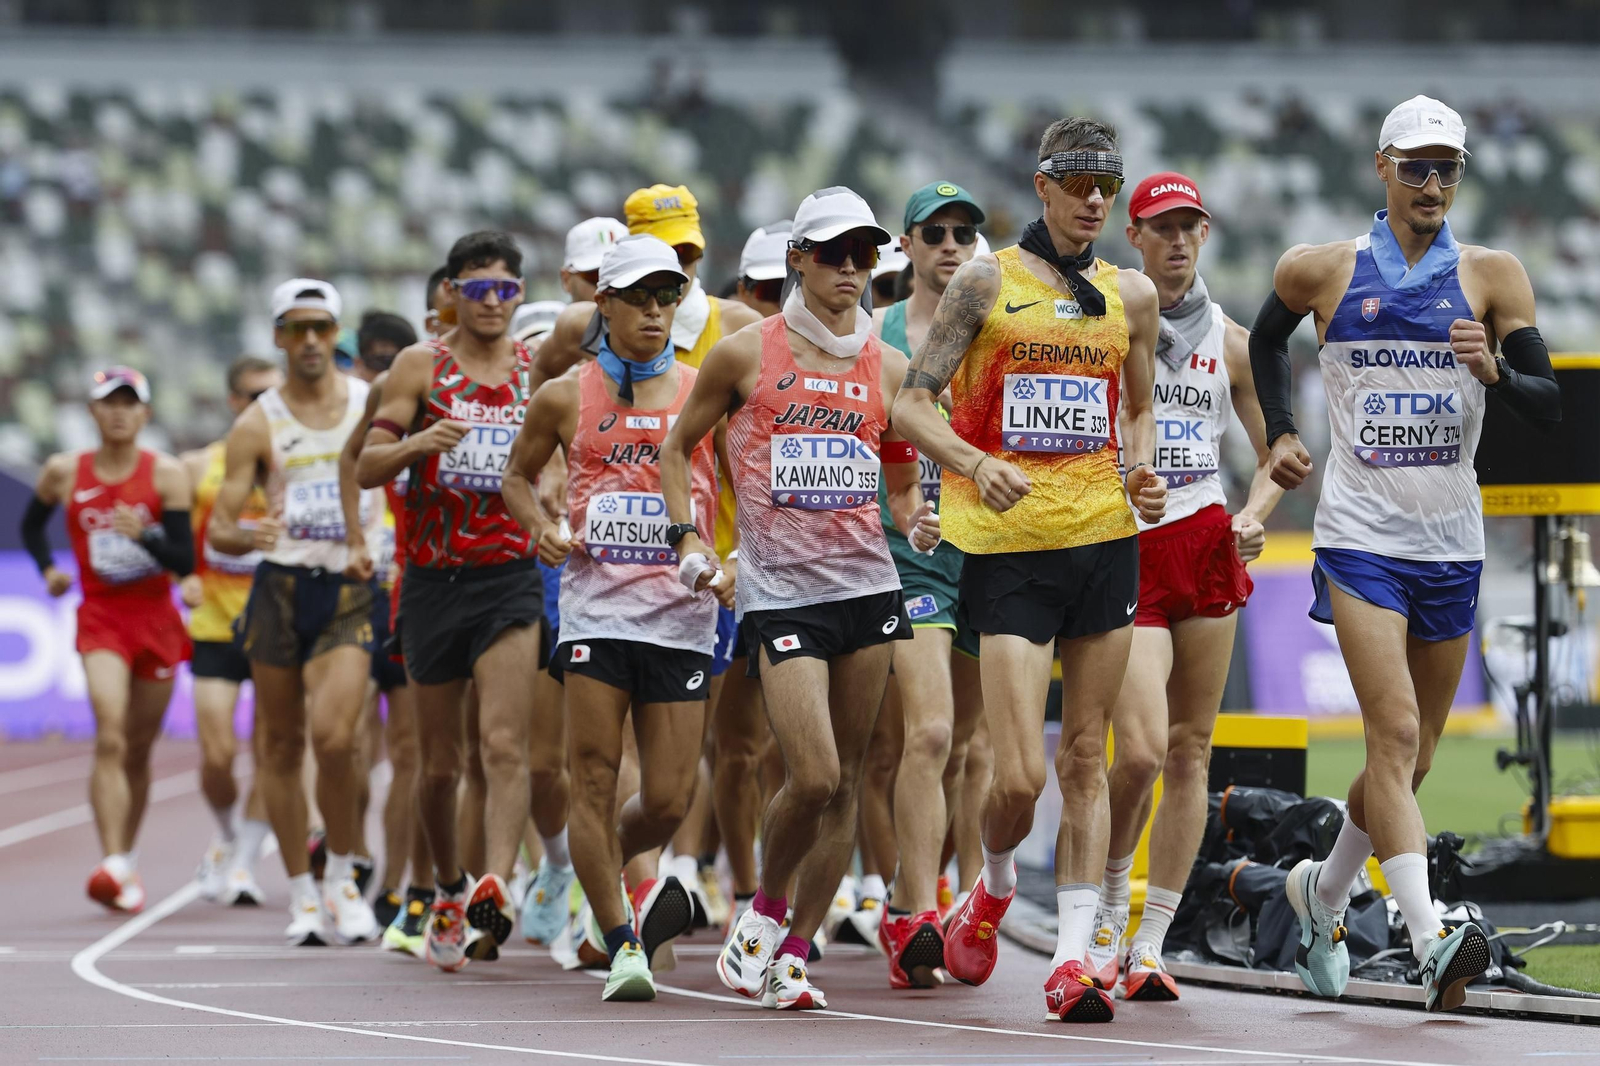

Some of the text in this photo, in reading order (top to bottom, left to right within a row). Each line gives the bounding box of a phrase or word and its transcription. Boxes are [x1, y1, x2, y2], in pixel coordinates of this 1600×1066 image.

[1428, 117, 1444, 126] SVK
[653, 196, 683, 211] SWE
[1011, 342, 1109, 366] GERMANY
[1351, 348, 1456, 369] SLOVAKIA
[807, 379, 836, 391] ACN
[1036, 378, 1102, 404] TDK
[1153, 384, 1211, 410] NADA
[1385, 393, 1457, 415] TDK
[451, 399, 527, 424] MÉXICO
[774, 402, 865, 433] JAPAN
[1009, 405, 1108, 434] LINKE 339
[473, 426, 517, 446] TD
[1359, 420, 1460, 446] ČERNÝ 374
[802, 437, 872, 460] TDK
[1195, 452, 1215, 467] 308
[776, 465, 877, 489] KAWANO 355
